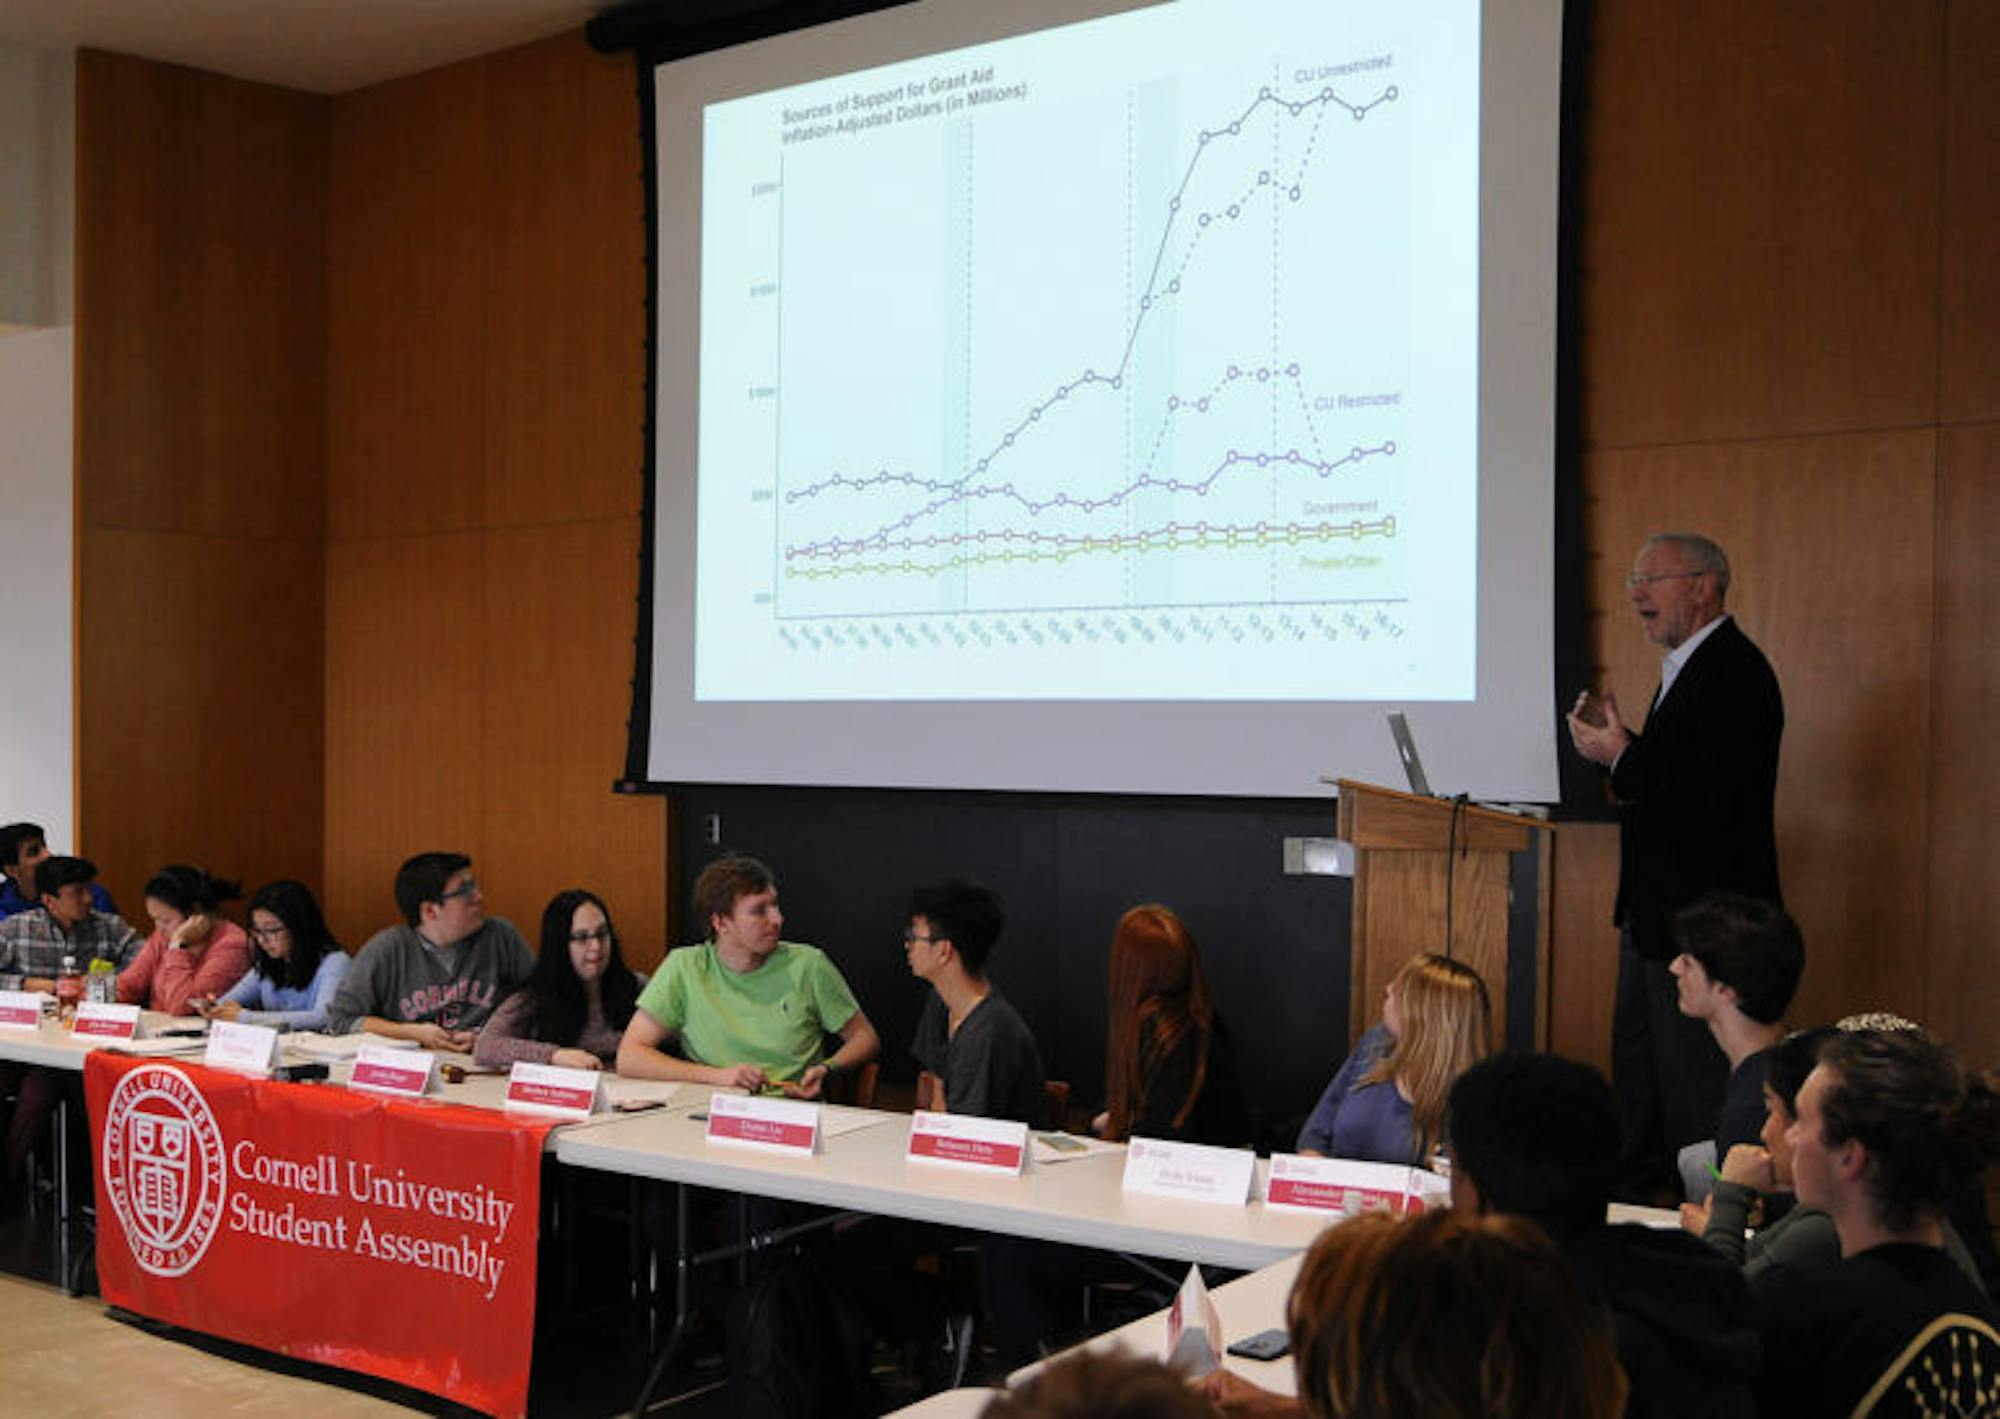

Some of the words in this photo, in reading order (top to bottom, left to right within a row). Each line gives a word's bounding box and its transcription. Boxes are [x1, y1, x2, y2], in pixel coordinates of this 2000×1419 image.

[781, 102, 833, 126] Sources
[834, 97, 850, 112] of
[850, 86, 904, 112] Support
[906, 81, 926, 98] for
[928, 73, 967, 95] Grant
[969, 65, 995, 83] Aid
[895, 100, 943, 123] Dollars
[966, 82, 1029, 108] Millions)
[232, 1140, 339, 1198] Cornell
[348, 1159, 514, 1243] University
[230, 1191, 348, 1252] Student
[354, 1217, 504, 1301] Assembly
